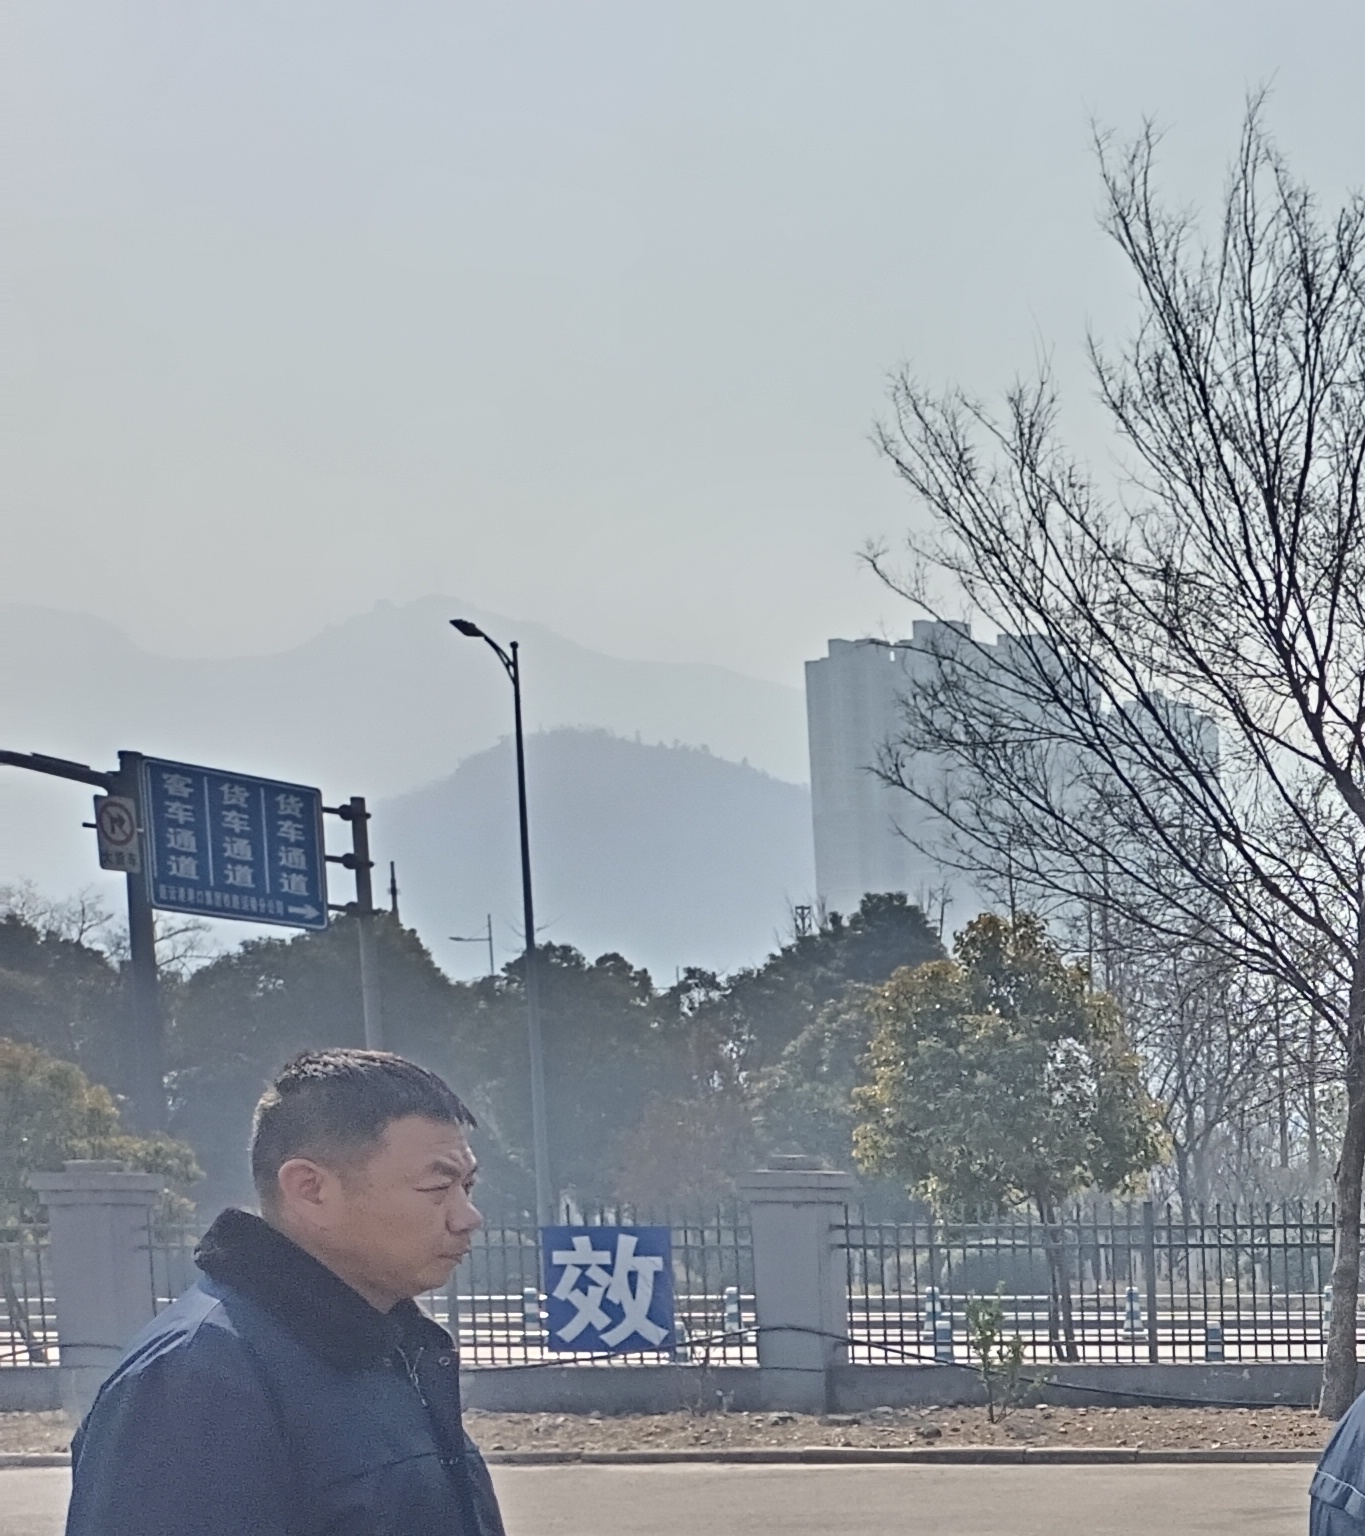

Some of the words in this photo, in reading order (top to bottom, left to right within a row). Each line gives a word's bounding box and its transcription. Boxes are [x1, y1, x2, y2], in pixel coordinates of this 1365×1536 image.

[162, 772, 199, 881] 客车通道
[219, 782, 255, 889] 货车通道
[275, 792, 309, 896] 货车通道
[552, 1233, 670, 1347] 效
